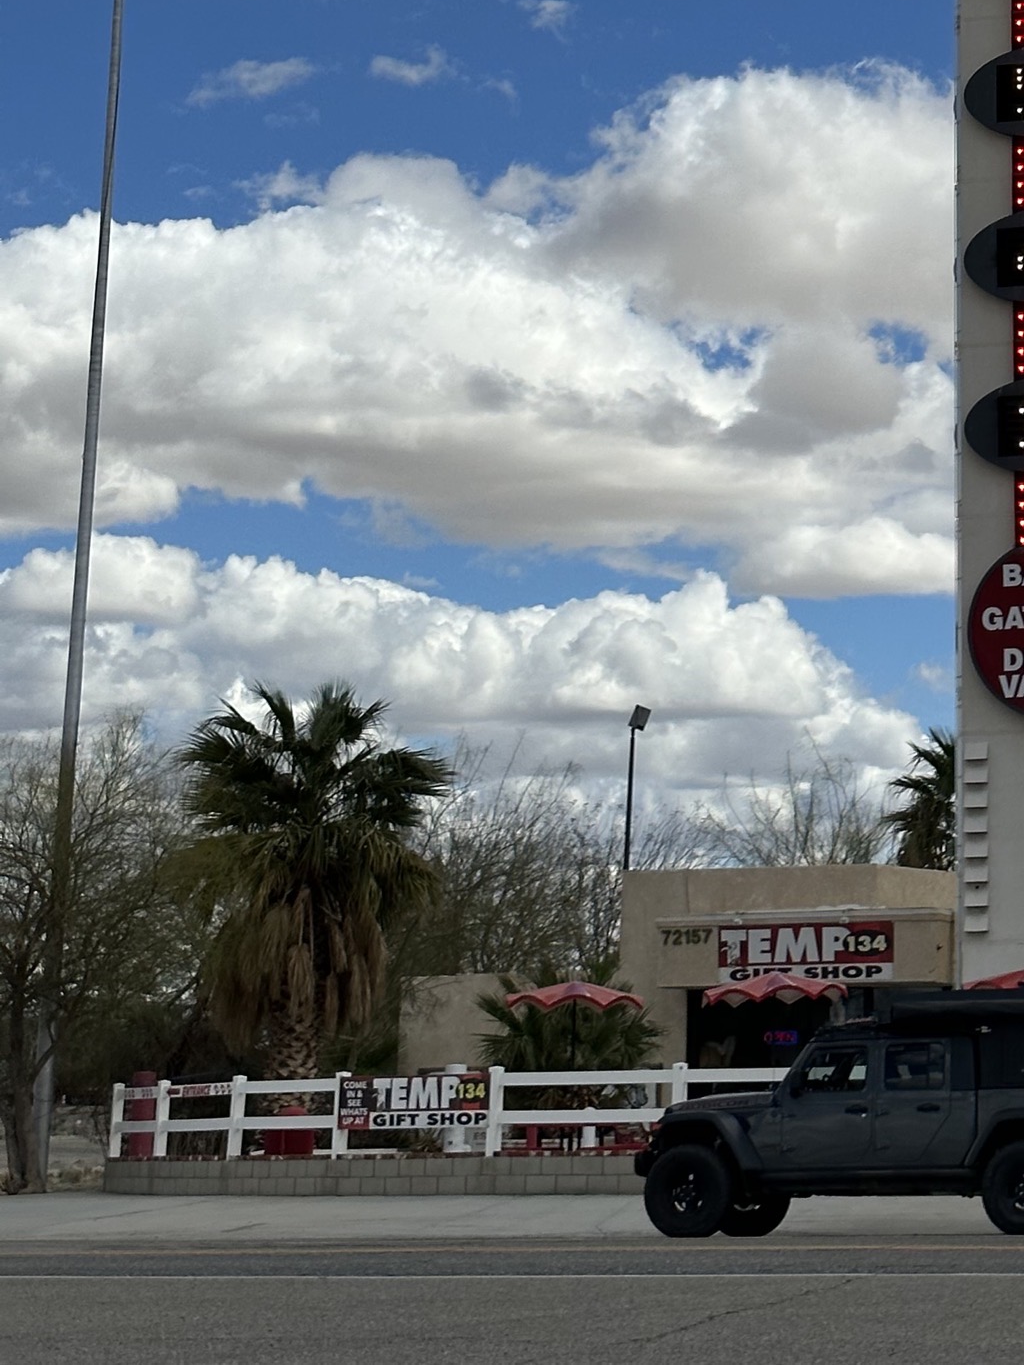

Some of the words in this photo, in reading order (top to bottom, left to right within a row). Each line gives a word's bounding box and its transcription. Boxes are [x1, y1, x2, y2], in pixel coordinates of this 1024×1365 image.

[661, 928, 713, 946] 72157
[720, 926, 851, 966] TEMP
[845, 935, 888, 952] 134
[804, 966, 883, 980] SHOP
[343, 1080, 368, 1089] COME
[372, 1076, 461, 1110] TEMP
[457, 1082, 486, 1099] 134
[347, 1099, 361, 1107] SEE
[372, 1113, 419, 1127] GIFT
[427, 1112, 487, 1125] SHOP
